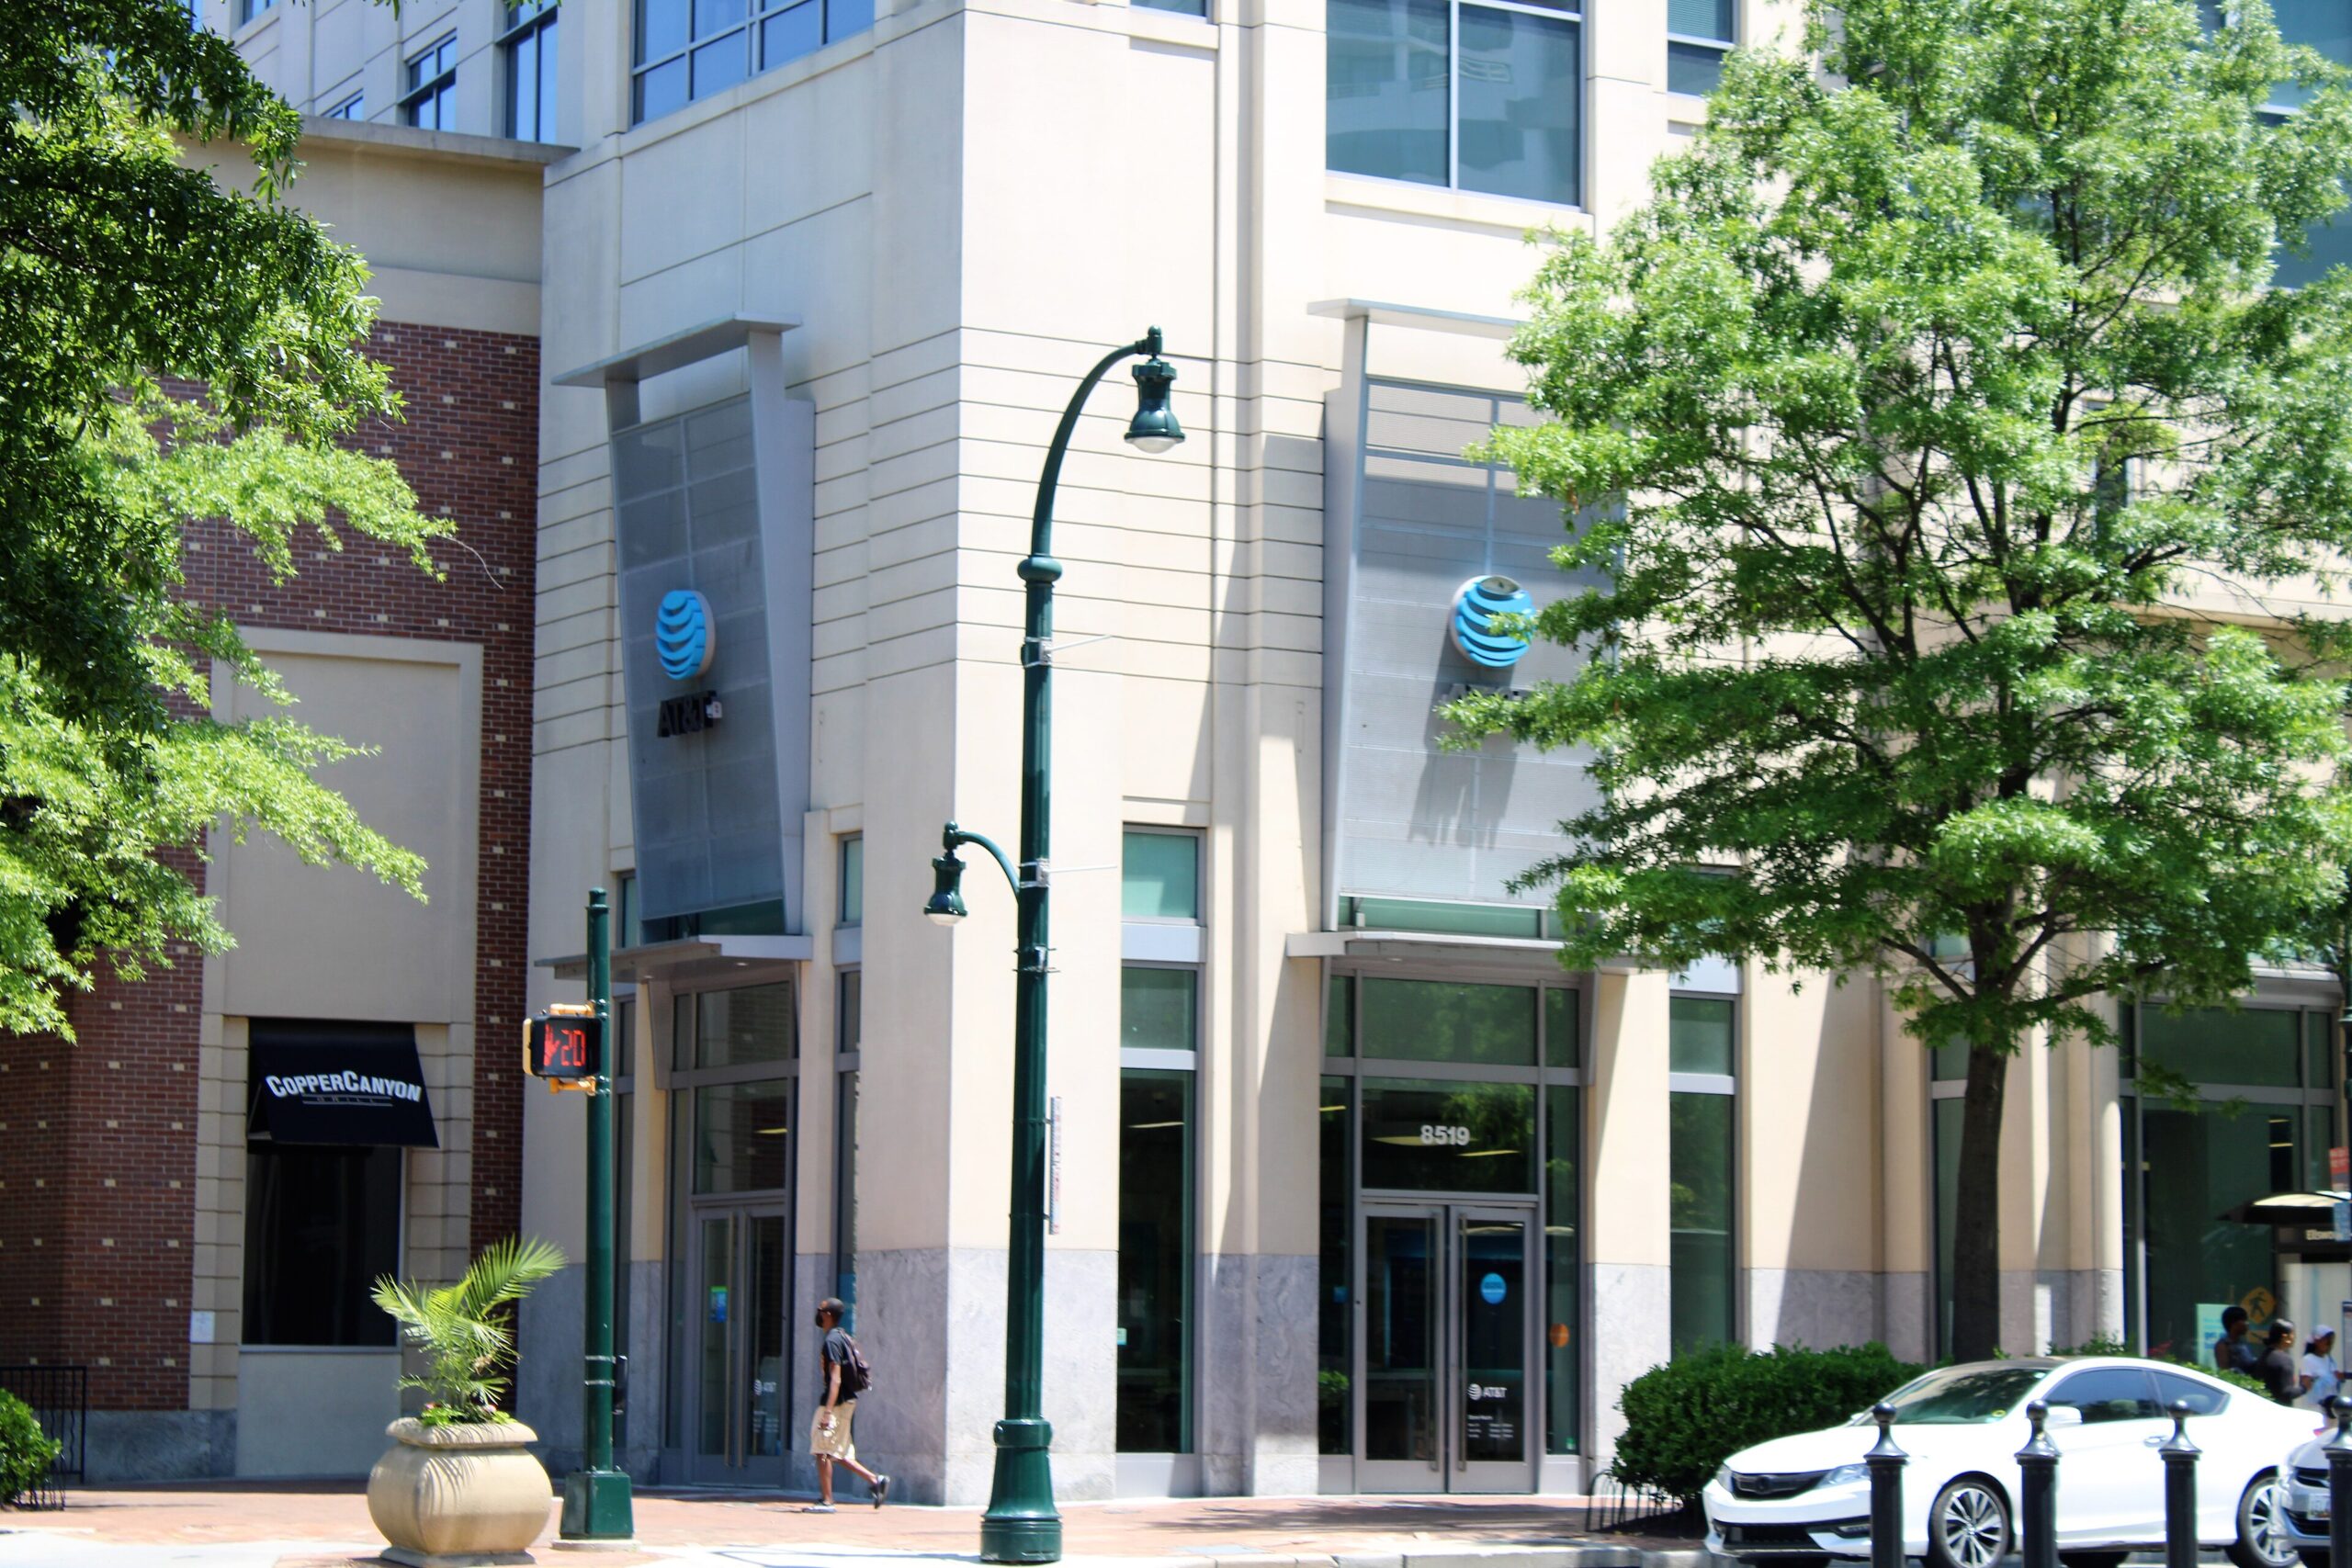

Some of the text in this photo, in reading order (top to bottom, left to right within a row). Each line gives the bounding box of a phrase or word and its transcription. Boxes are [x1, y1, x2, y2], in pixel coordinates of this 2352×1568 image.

[658, 691, 716, 738] AT&T
[560, 1029, 586, 1066] 20
[1420, 1124, 1470, 1146] 8519
[1483, 1386, 1508, 1398] AT&T
